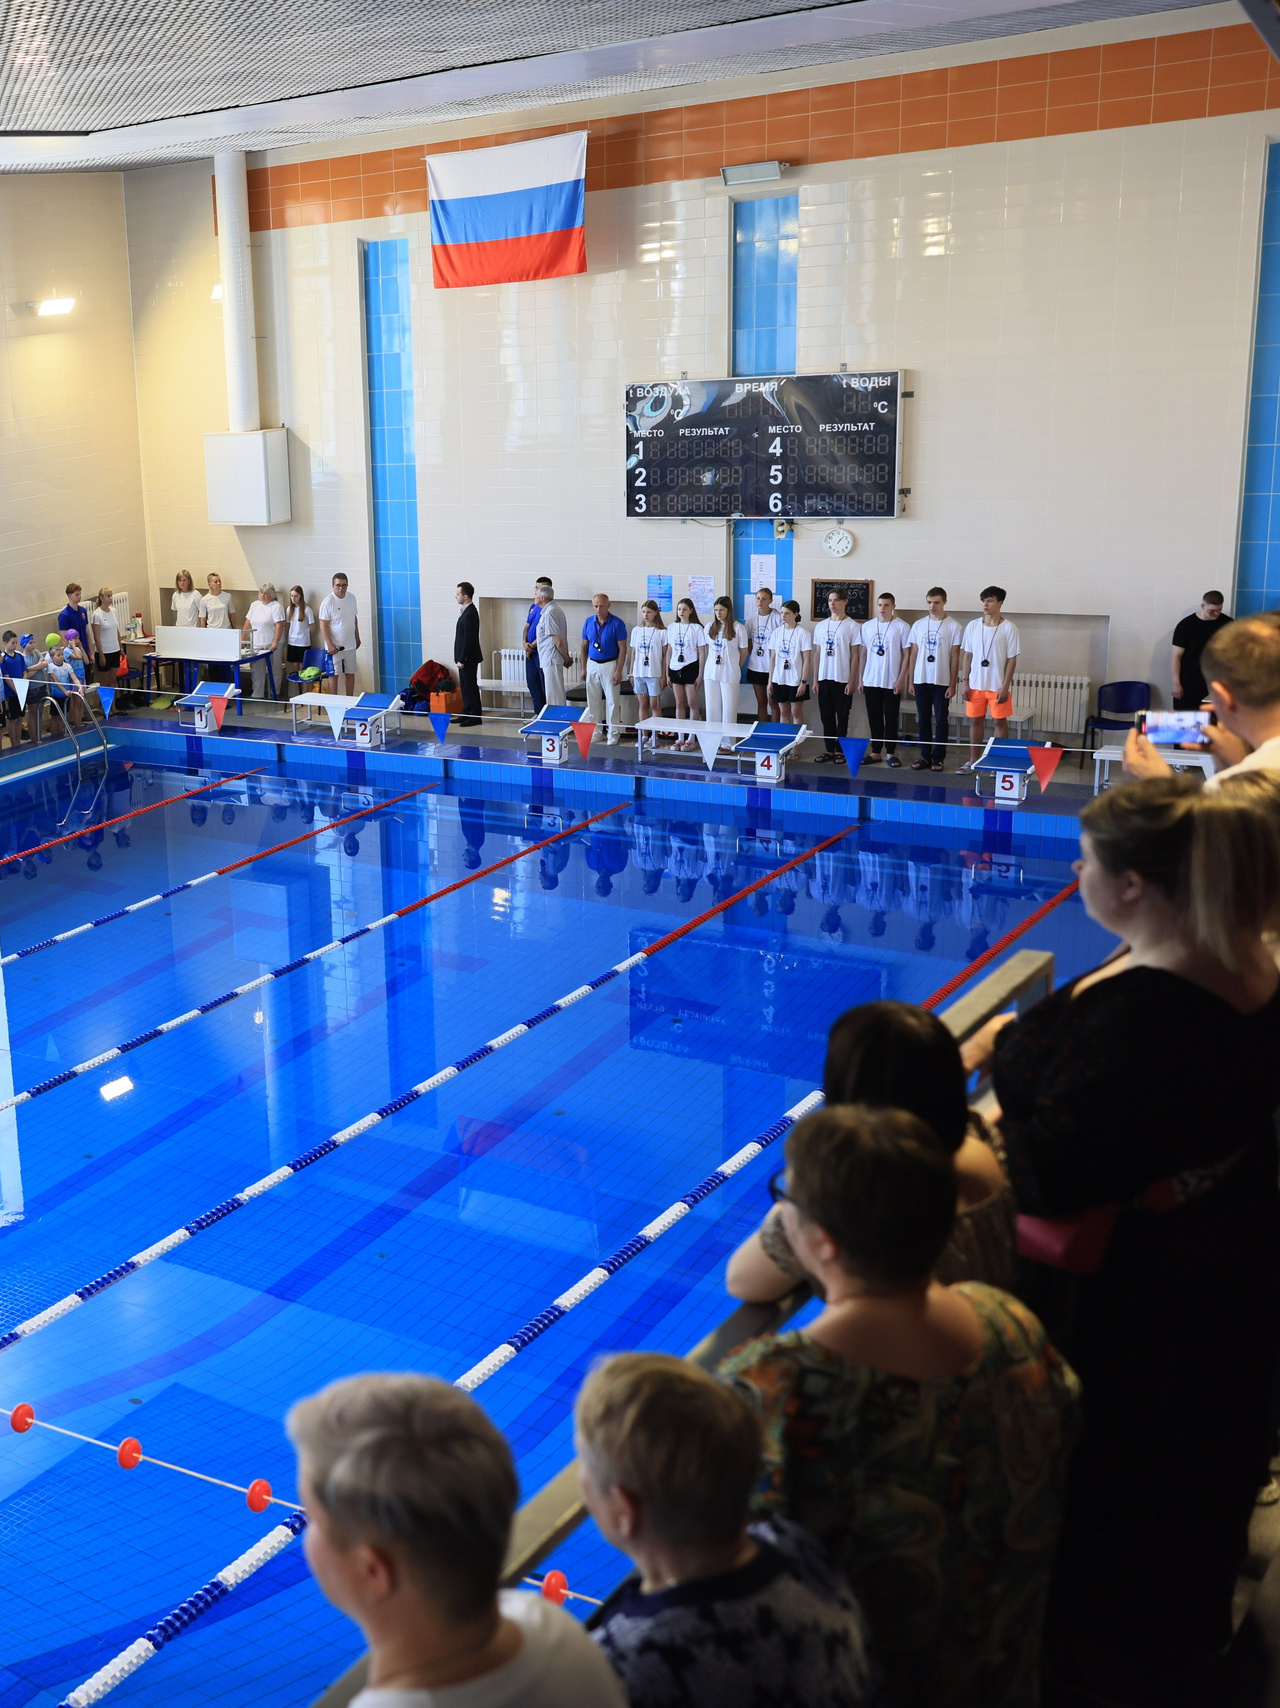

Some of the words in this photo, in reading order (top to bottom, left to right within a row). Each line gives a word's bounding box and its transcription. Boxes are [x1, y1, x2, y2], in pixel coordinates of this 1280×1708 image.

[735, 382, 777, 393] ВРЕМЯ
[851, 376, 890, 391] ВОДЫ
[636, 386, 691, 398] ВОЗДУХА
[633, 430, 664, 438] МЕСТО
[679, 427, 730, 437] РЕЗУЛЬТАТ
[768, 425, 802, 433] МЕСТО
[819, 423, 875, 432] РЕЗУЛЬТАТ
[634, 440, 644, 460] 1
[769, 436, 783, 457] 4
[634, 467, 647, 487] 2
[769, 465, 783, 485] 5
[634, 494, 647, 513] 3
[769, 493, 783, 513] 6
[196, 709, 203, 722] 1
[359, 722, 368, 736] 2
[376, 724, 380, 734] 2
[546, 738, 556, 752] 3
[760, 755, 773, 770] 4
[1001, 774, 1014, 791] 5
